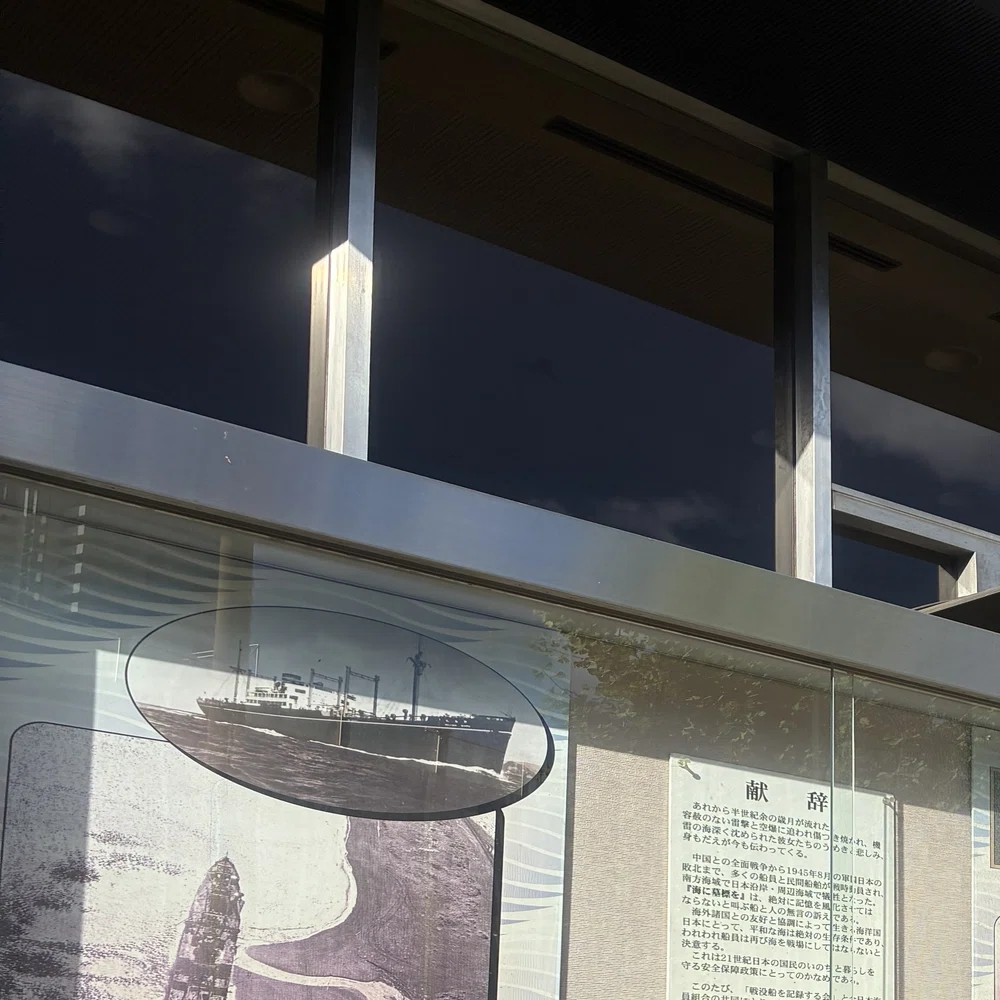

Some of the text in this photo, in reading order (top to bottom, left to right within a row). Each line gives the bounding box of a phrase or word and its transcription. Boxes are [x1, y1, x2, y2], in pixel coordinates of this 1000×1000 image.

[746, 780, 828, 812] 献 辞
[682, 939, 725, 951] 決意する。
